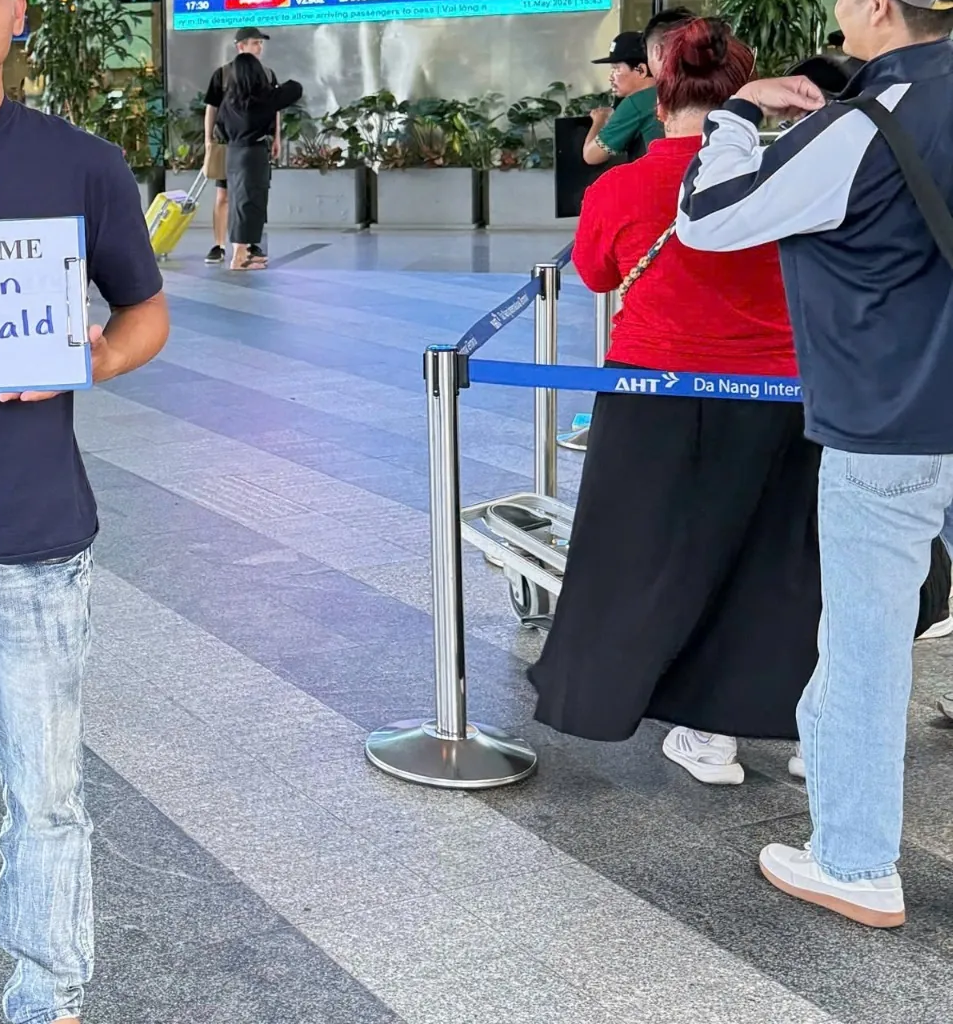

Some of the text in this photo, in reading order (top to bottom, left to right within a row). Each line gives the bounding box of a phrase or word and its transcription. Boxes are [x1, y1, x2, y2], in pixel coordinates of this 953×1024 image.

[185, 0, 209, 11] 17:30
[534, 0, 551, 8] May
[197, 17, 209, 25] the
[212, 15, 256, 26] designated
[281, 12, 290, 21] to
[292, 11, 314, 20] allow
[316, 9, 349, 20] arriving
[350, 7, 400, 19] passengers
[402, 6, 411, 15] to
[614, 376, 802, 398] AHT Da Nang Inter
